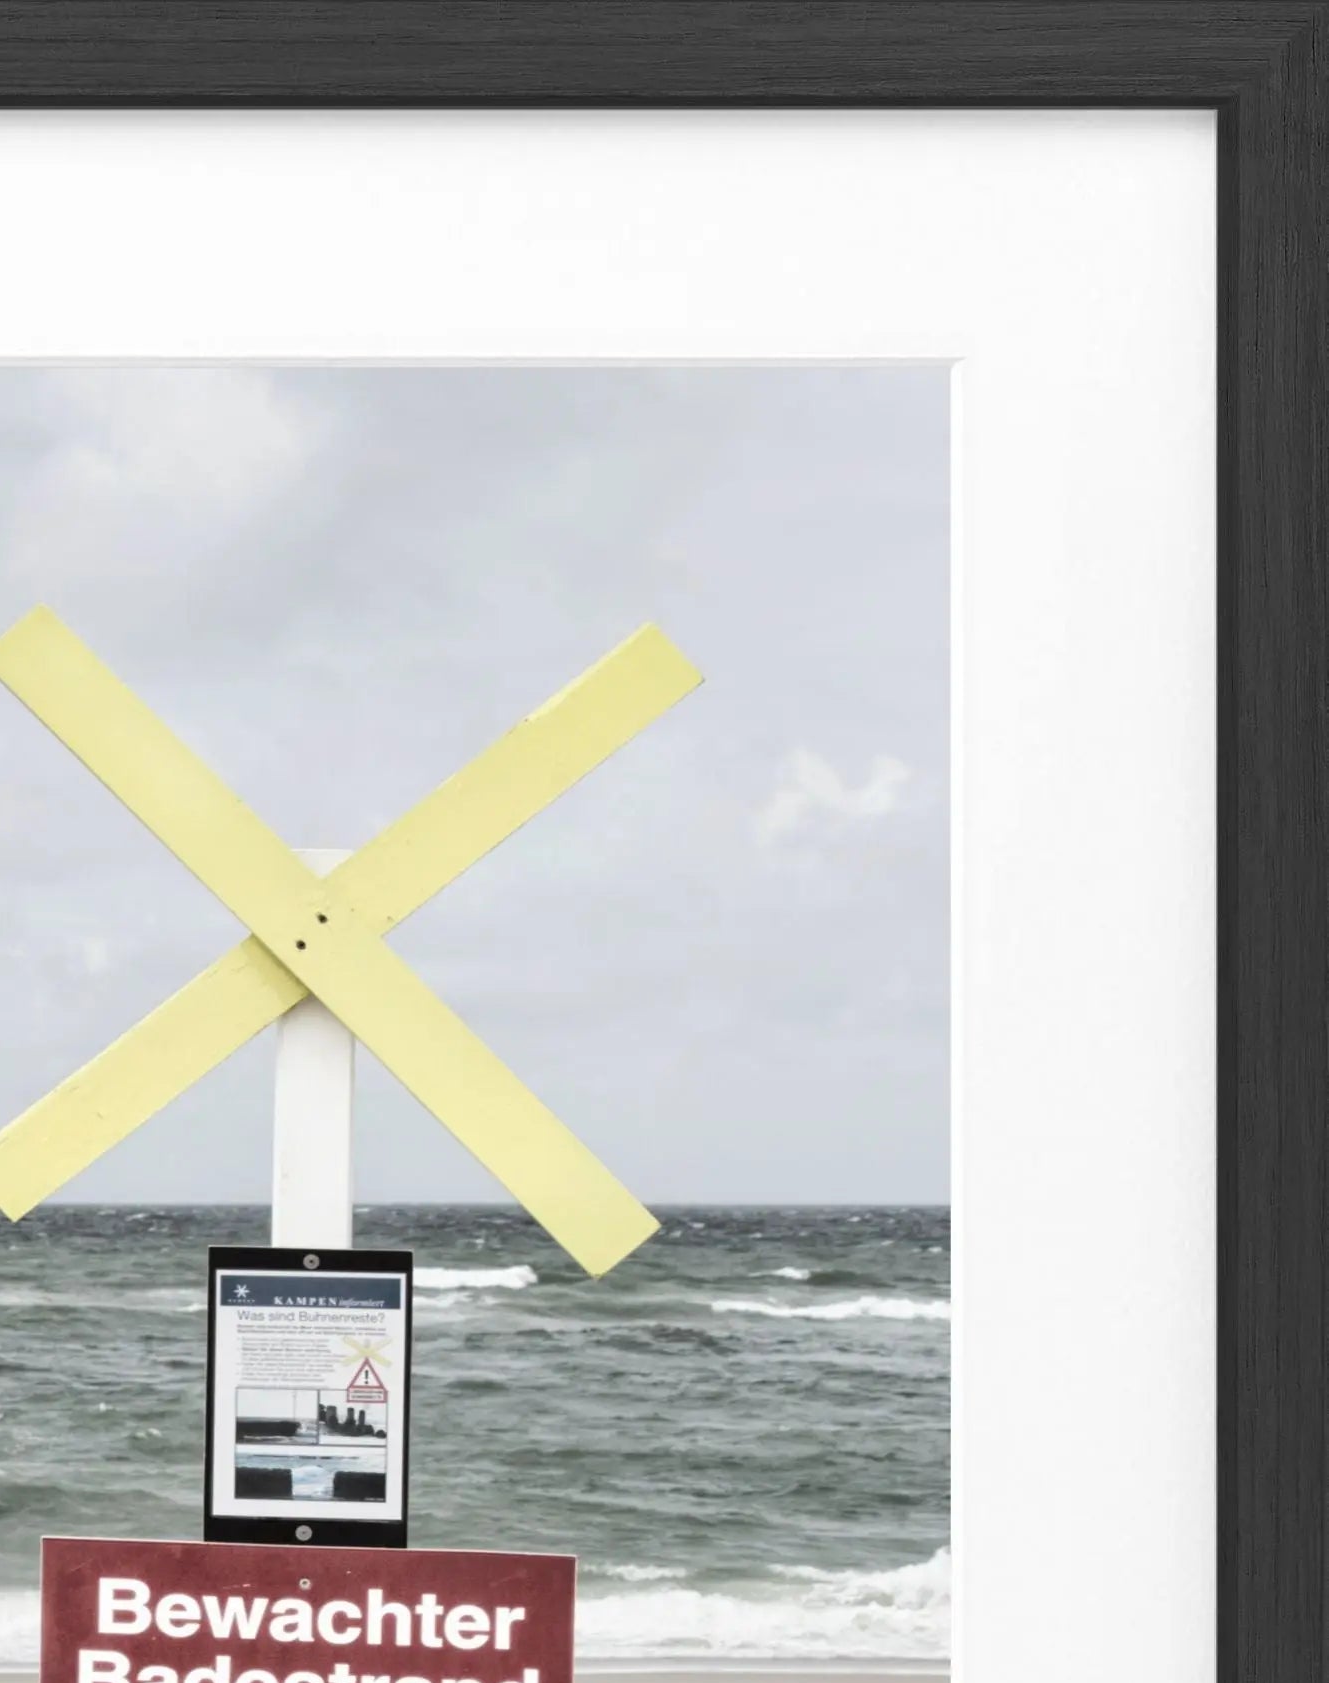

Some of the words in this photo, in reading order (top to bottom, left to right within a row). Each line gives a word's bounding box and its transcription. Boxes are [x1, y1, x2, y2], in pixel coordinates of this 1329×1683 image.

[273, 1295, 338, 1307] KAMPEN
[236, 1309, 265, 1321] Was
[268, 1310, 296, 1322] sind
[298, 1310, 386, 1325] Buhnenreste?
[97, 1576, 526, 1651] Bewachter
